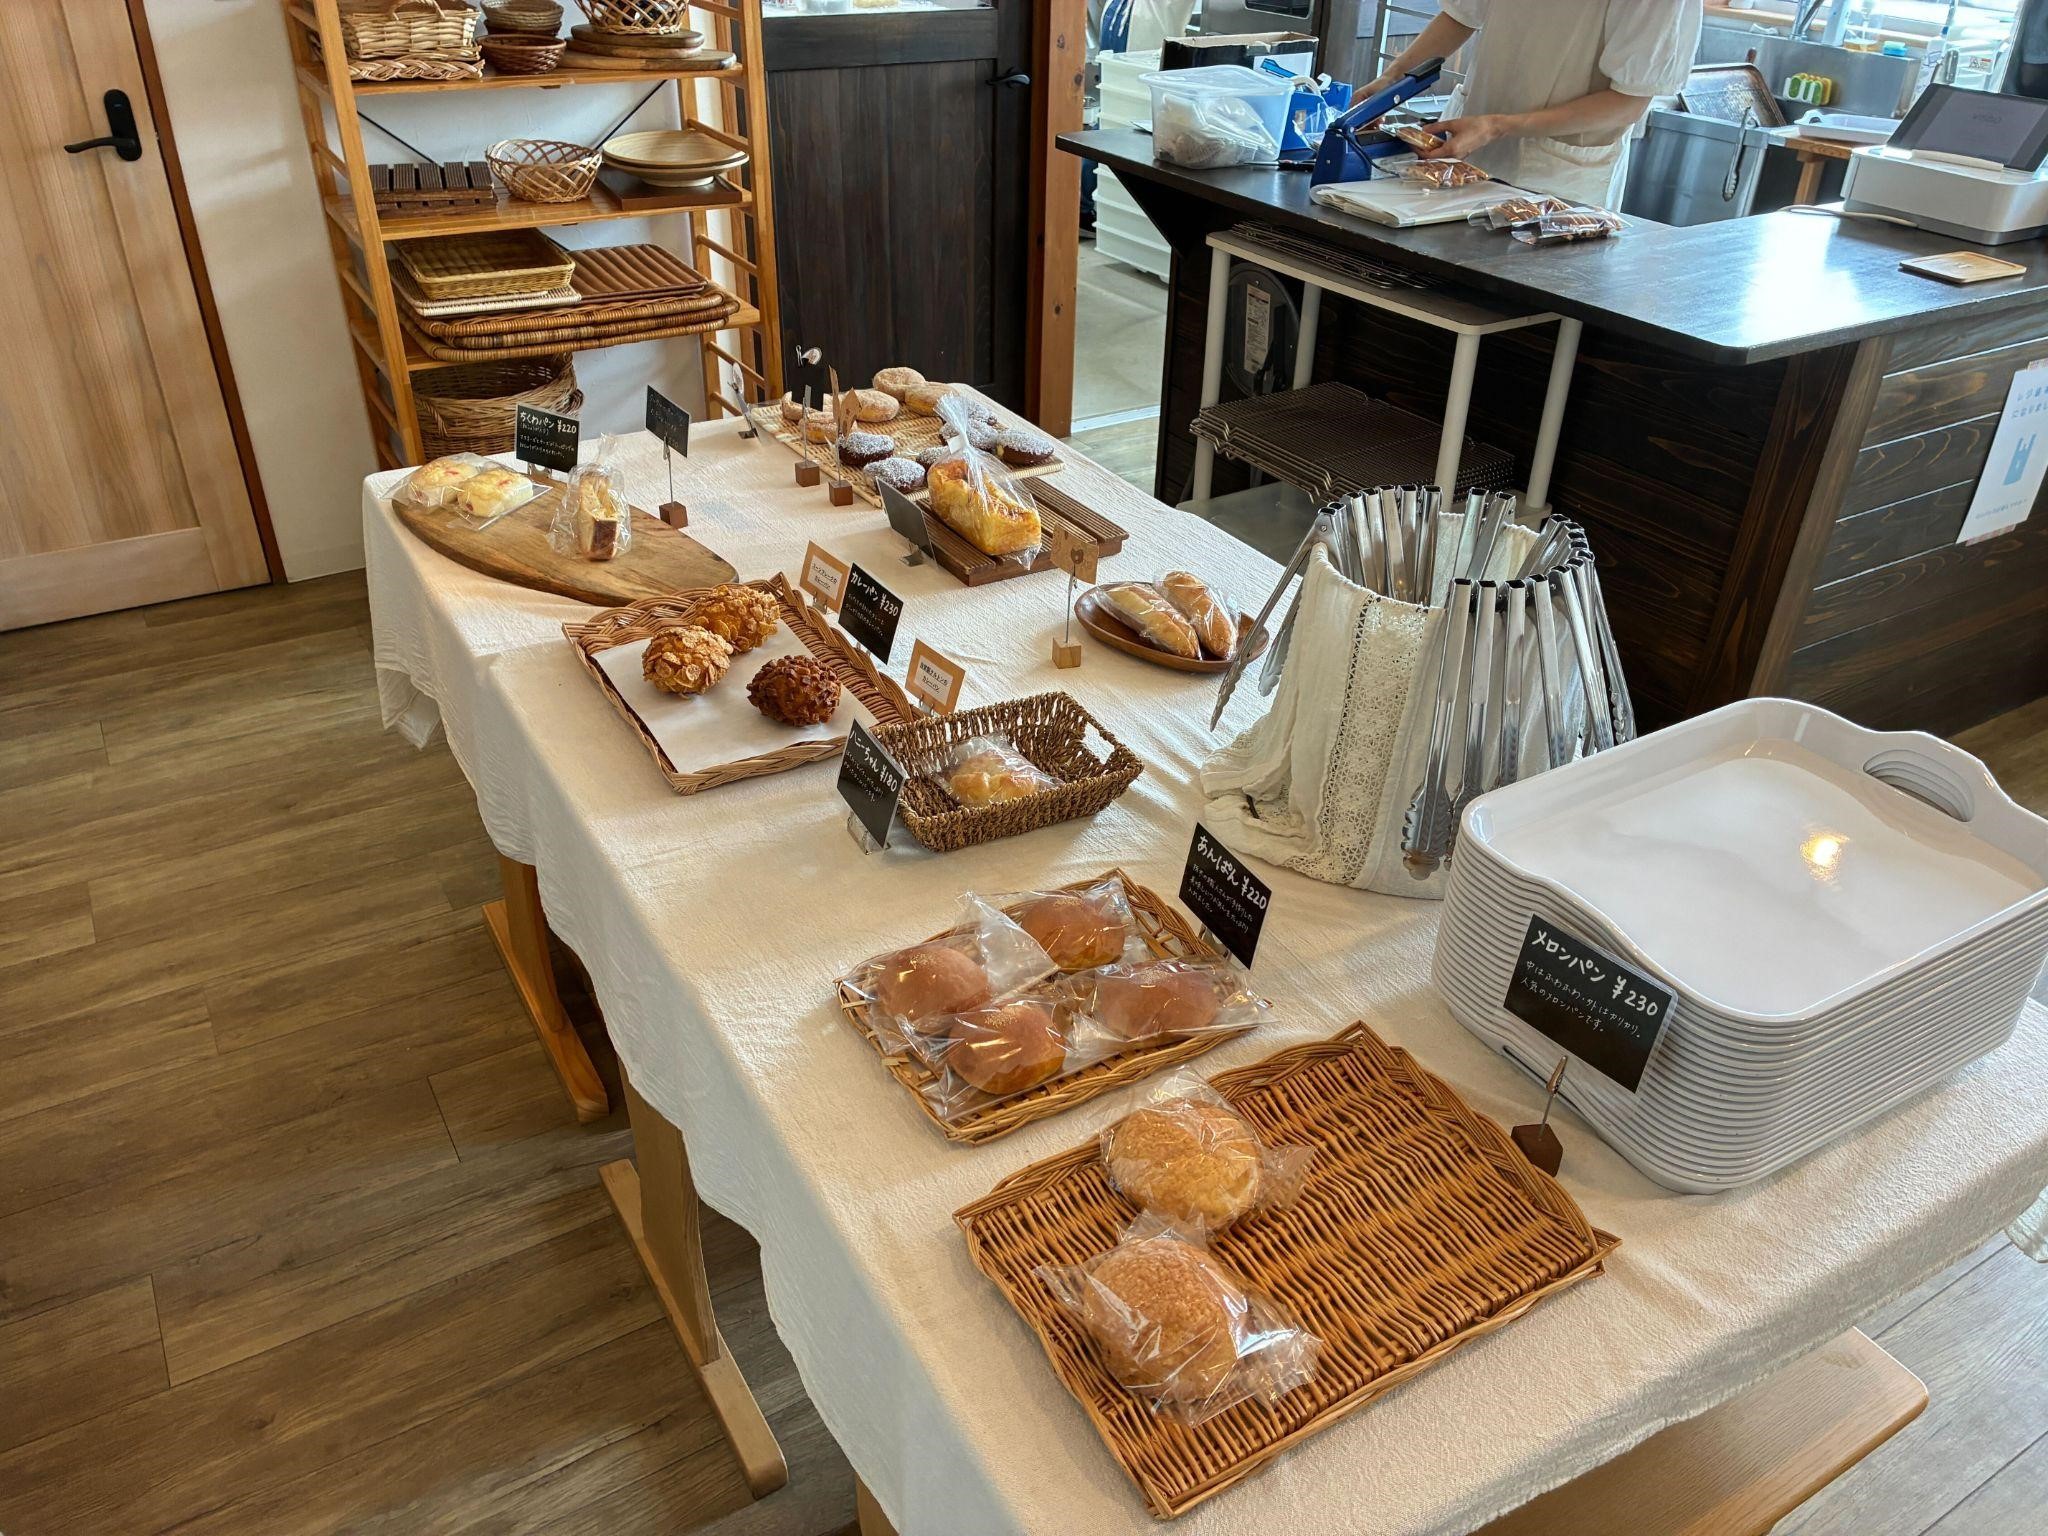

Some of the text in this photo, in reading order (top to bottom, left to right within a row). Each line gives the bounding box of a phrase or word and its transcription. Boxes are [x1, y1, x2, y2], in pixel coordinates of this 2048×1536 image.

[520, 411, 555, 429] ちくわパン
[557, 419, 577, 434] ¥220
[850, 571, 899, 617] カレーパン ¥230
[849, 730, 899, 792] ハニーちゃん ¥180
[1197, 835, 1267, 910] あんぱん ¥220
[1531, 929, 1659, 1017] メロンパン ¥230
